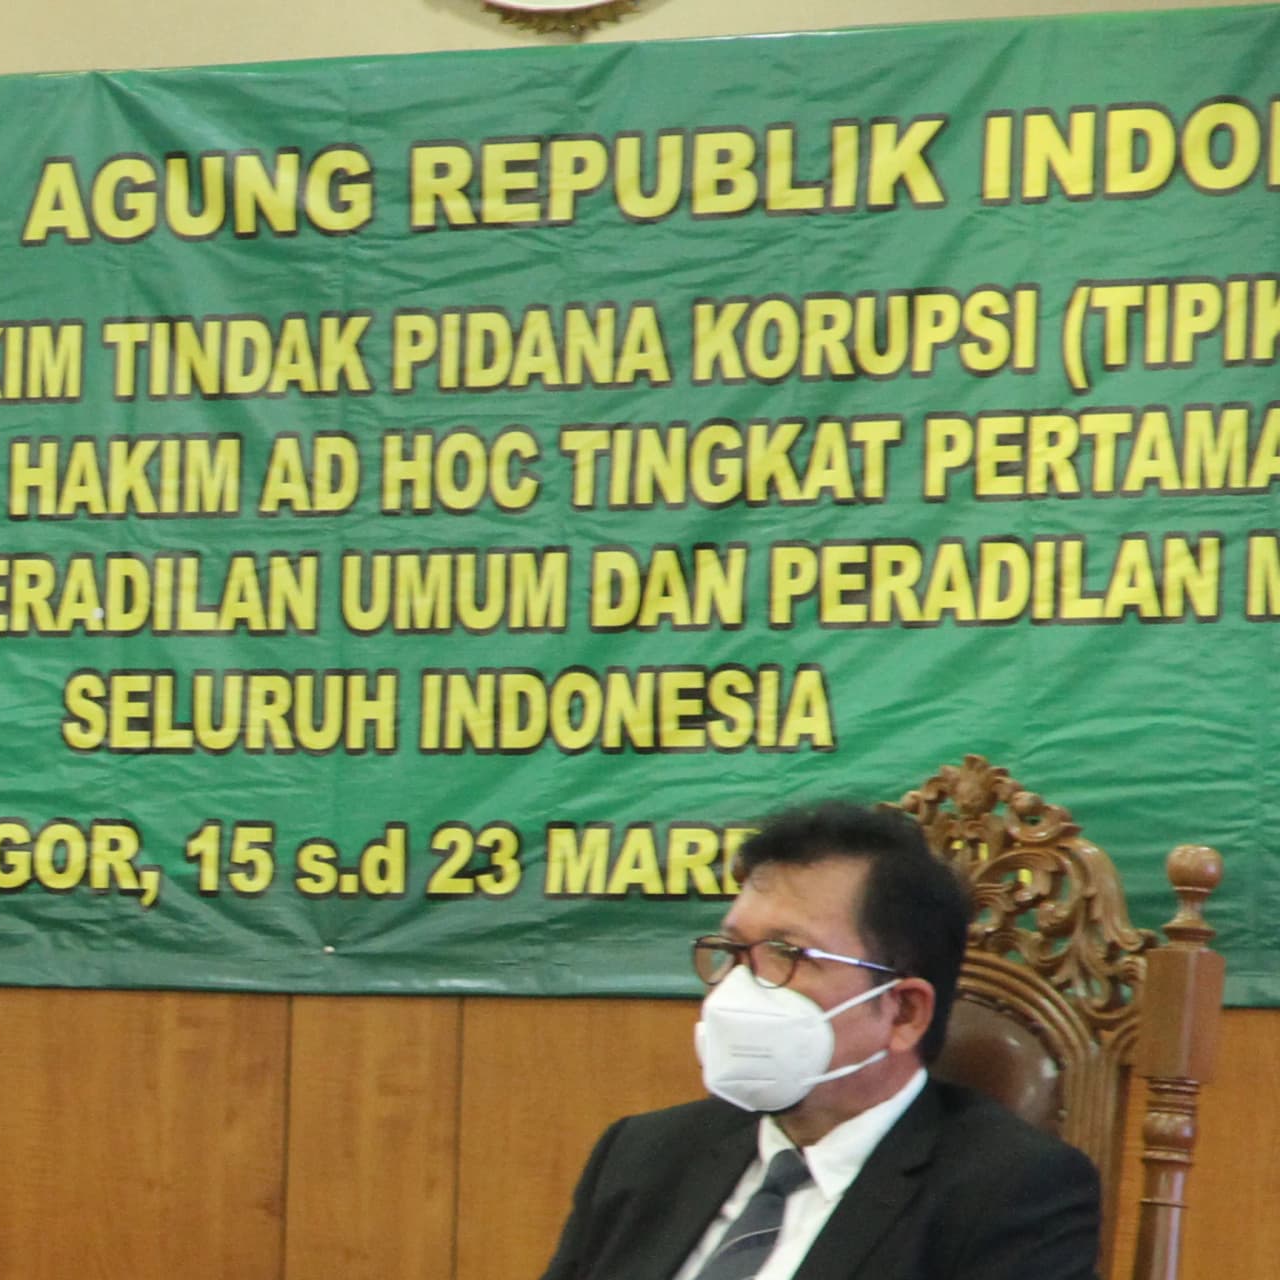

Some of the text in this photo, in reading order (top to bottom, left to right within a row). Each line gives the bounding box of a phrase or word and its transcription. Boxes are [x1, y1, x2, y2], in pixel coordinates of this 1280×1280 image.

[22, 147, 374, 244] AGUNG
[410, 117, 946, 228] REPUBLIK
[981, 98, 1280, 202] INDO
[102, 313, 372, 399] TINDAK
[391, 303, 672, 392] PIDANA
[691, 287, 1039, 382] KORUPSI
[8, 436, 242, 518] HAKIM
[258, 433, 361, 514] AD
[381, 428, 540, 512] HOC
[559, 417, 904, 508] TINGKAT
[341, 549, 569, 633] UMUM
[590, 546, 748, 630] DAN
[768, 534, 1222, 626] PERADILAN
[61, 667, 834, 753] SELURUH INDONESIA
[185, 822, 276, 895] 15
[296, 825, 407, 897] s.d
[426, 824, 523, 898] 23
